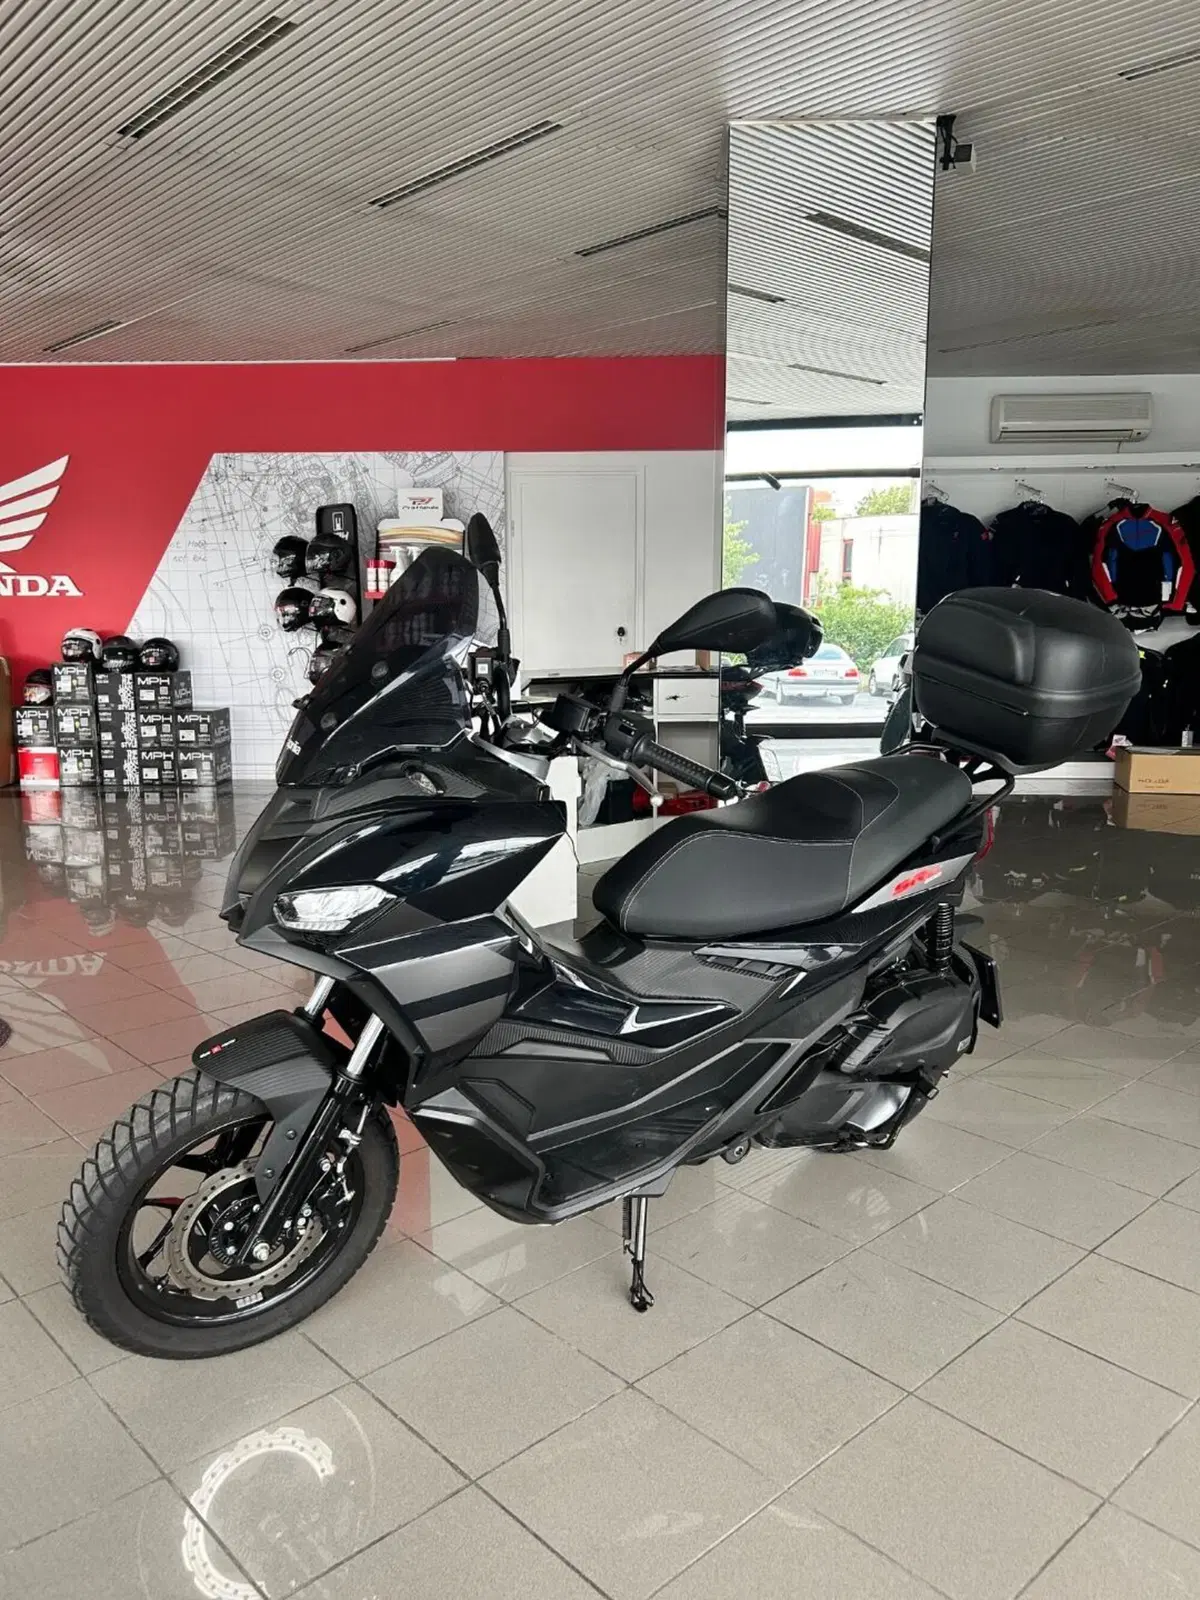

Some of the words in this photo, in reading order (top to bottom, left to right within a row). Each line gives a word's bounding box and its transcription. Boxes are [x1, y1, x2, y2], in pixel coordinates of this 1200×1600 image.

[54, 666, 88, 676] MPH
[137, 676, 171, 686] MPH
[15, 709, 50, 719] MPH
[57, 708, 91, 717] MPH
[140, 714, 173, 723] MPH
[177, 714, 211, 723] MPH
[60, 748, 94, 758] MPH
[141, 751, 174, 760] MPH
[180, 752, 213, 761] MPH
